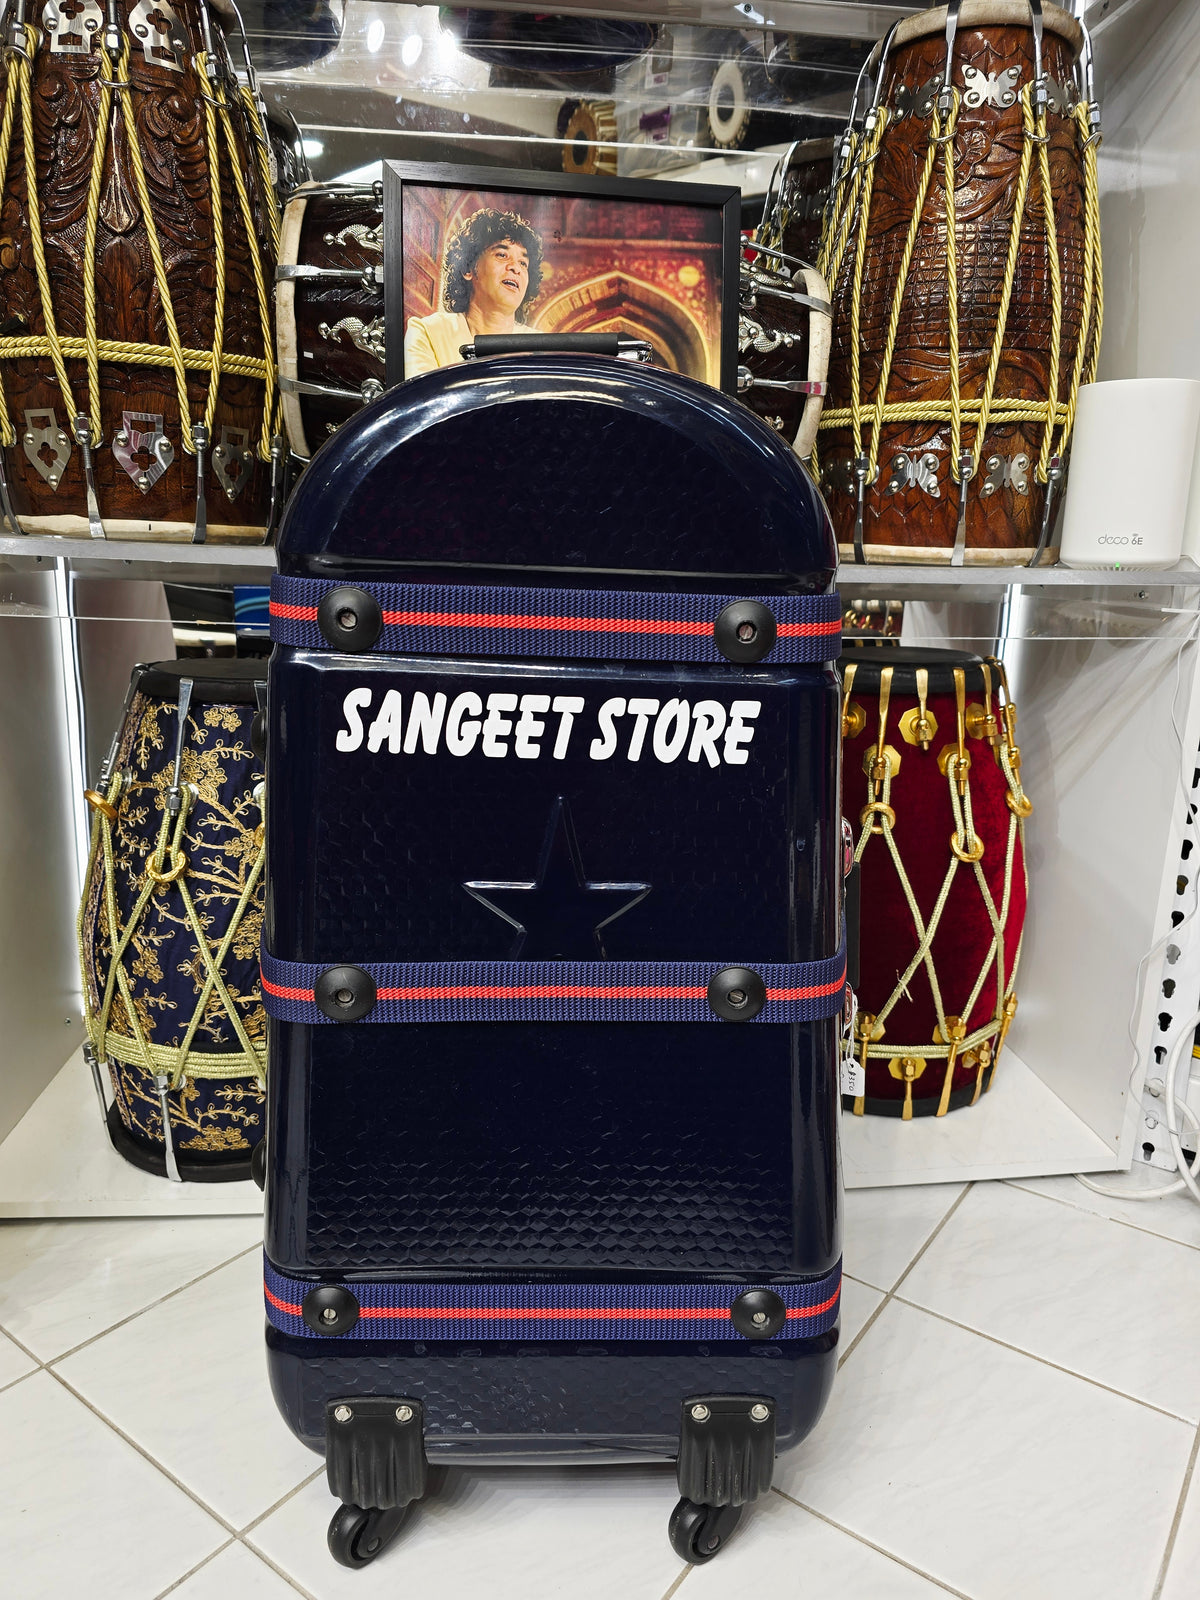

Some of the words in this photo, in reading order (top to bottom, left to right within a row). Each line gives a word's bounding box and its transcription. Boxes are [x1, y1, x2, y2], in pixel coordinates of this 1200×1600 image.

[1098, 533, 1129, 545] deco
[1131, 536, 1143, 545] 6E
[336, 687, 585, 760] SANGEET
[589, 697, 762, 768] STORE
